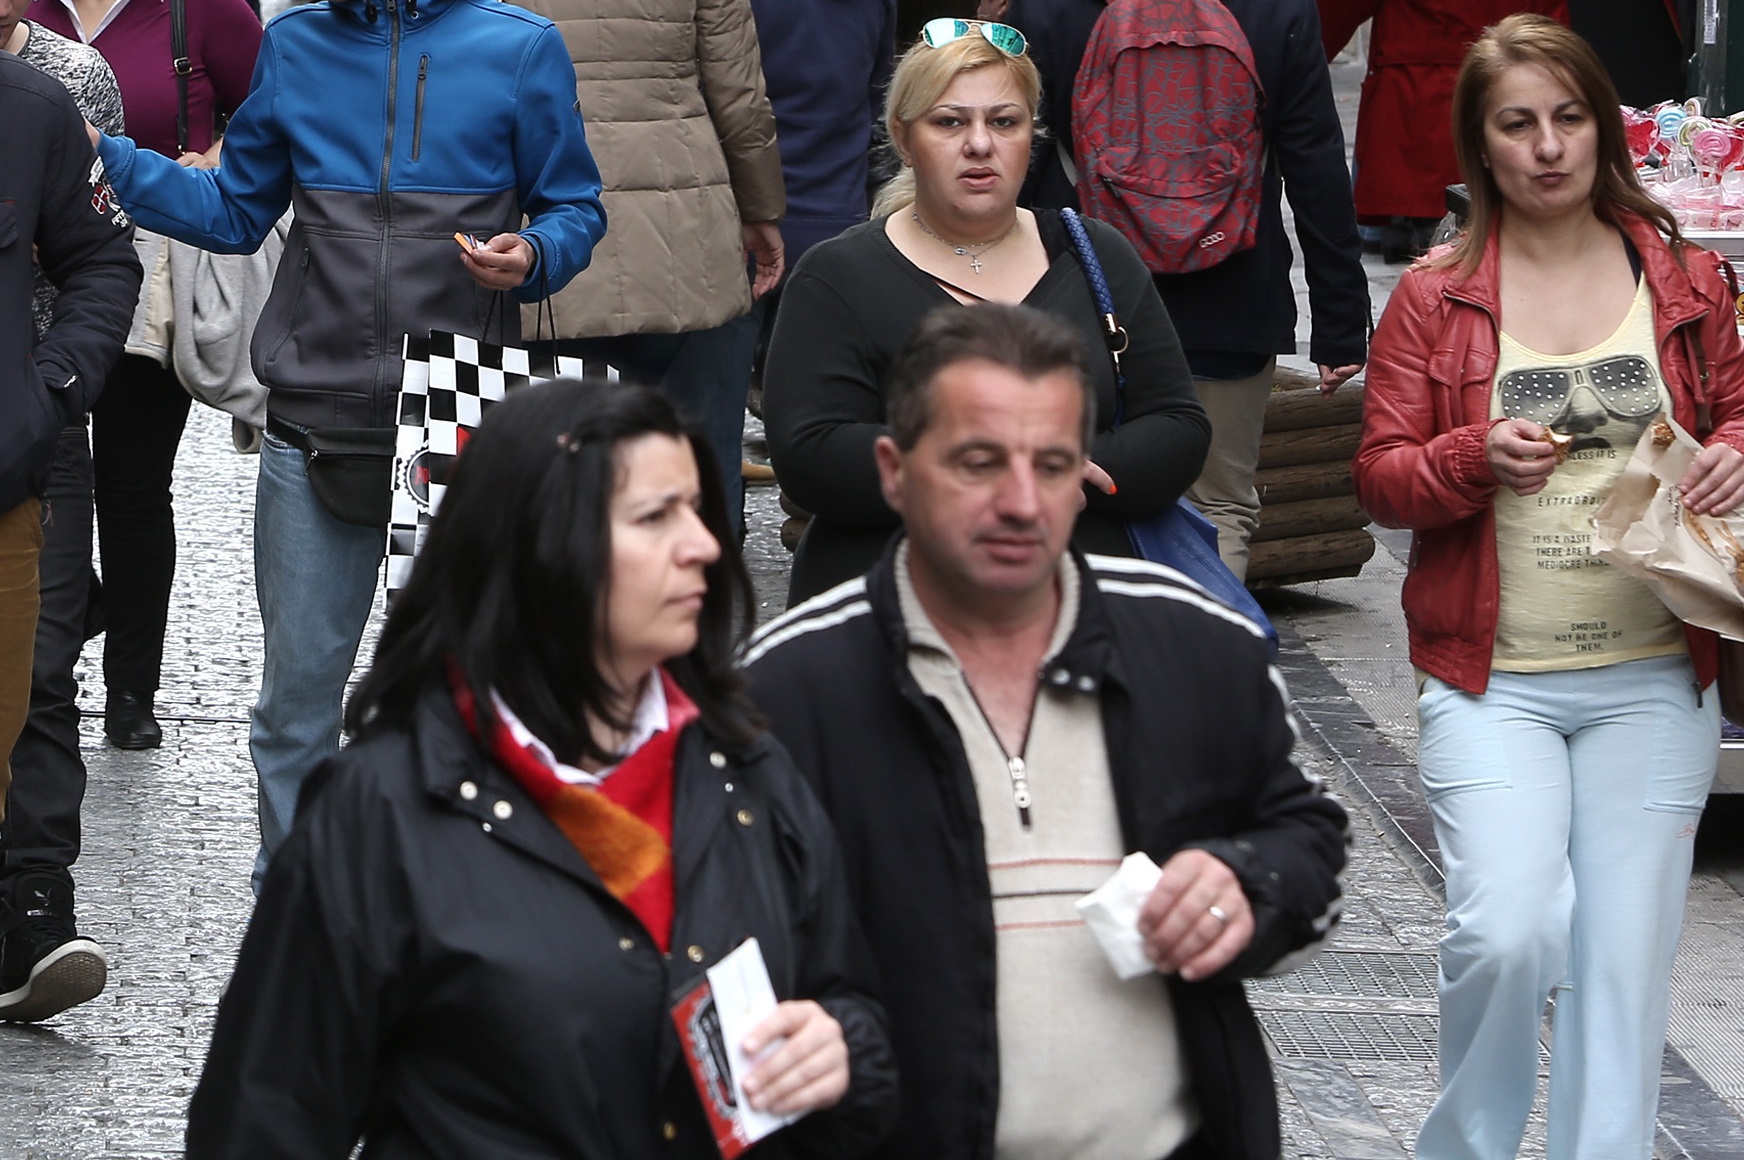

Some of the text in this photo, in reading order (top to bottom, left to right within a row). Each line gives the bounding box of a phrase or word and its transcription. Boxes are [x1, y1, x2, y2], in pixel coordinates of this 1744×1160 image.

[1570, 621, 1607, 632] SHOULD
[1554, 634, 1572, 643] NOT
[1590, 631, 1609, 641] ONE
